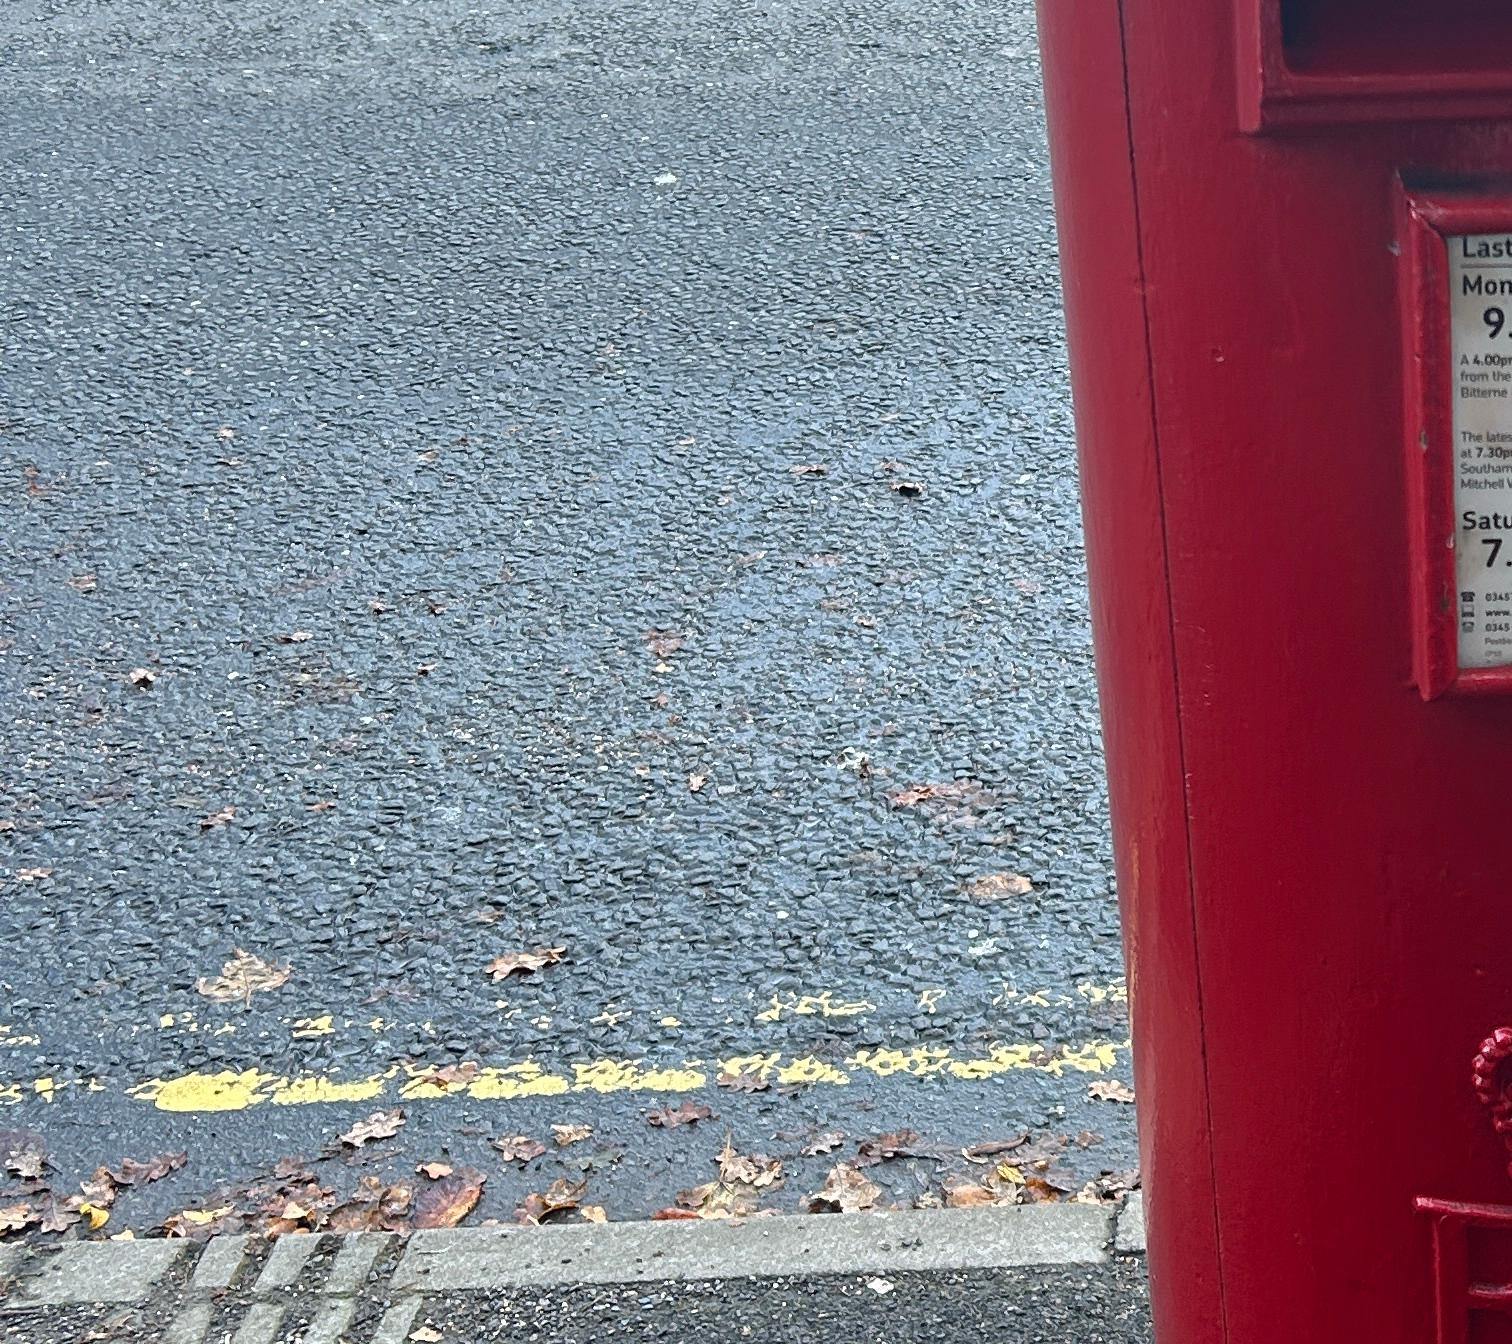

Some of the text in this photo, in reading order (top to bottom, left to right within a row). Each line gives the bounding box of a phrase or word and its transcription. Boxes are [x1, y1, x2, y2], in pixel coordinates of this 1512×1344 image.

[1460, 355, 1469, 366] A
[1460, 371, 1488, 382] from
[1493, 371, 1511, 381] the
[1460, 387, 1507, 399] Bitterne
[1461, 431, 1482, 442] The
[1460, 448, 1472, 458] at
[1460, 478, 1504, 489] Mitchell
